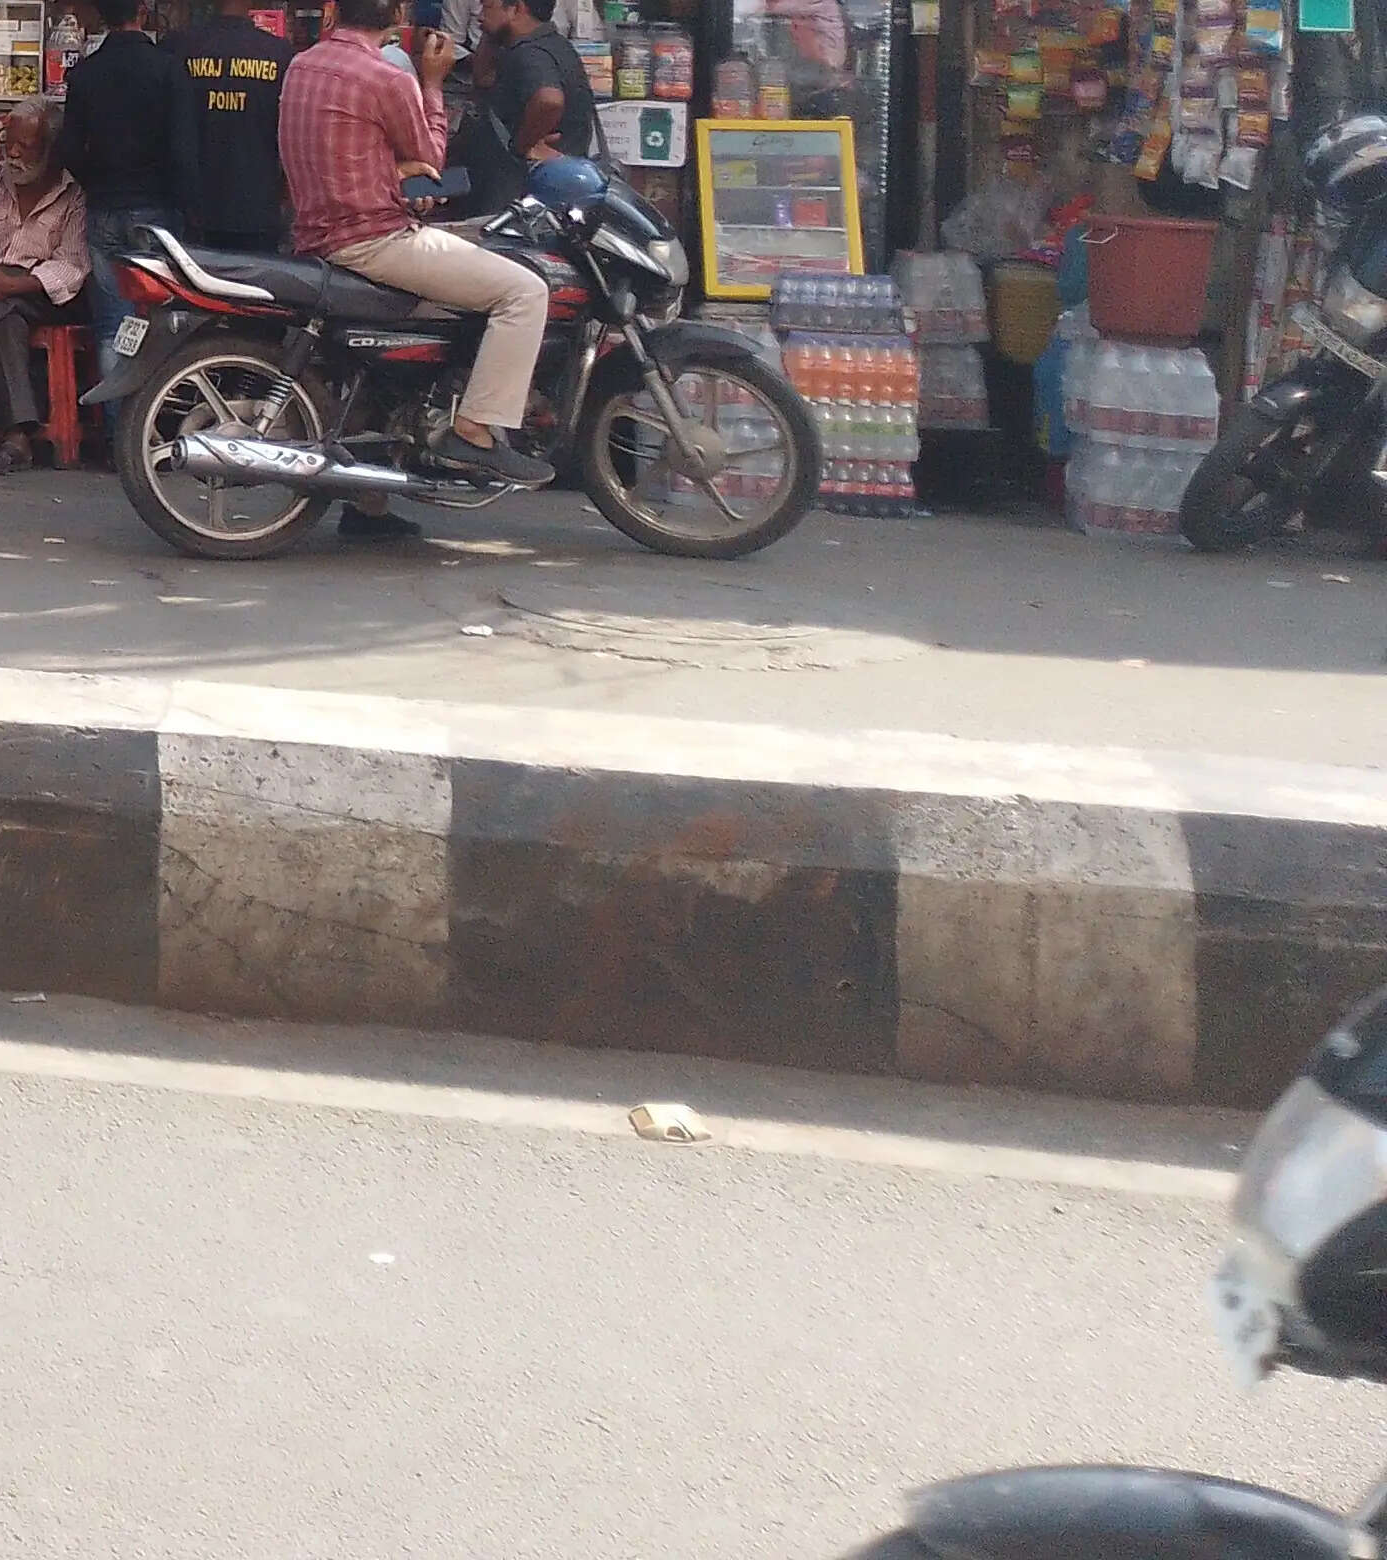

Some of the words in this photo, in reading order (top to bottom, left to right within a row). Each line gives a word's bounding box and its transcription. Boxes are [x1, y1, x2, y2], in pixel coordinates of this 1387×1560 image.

[229, 57, 278, 81] NONVEG
[208, 90, 247, 112] POINT
[347, 337, 375, 348] CD
